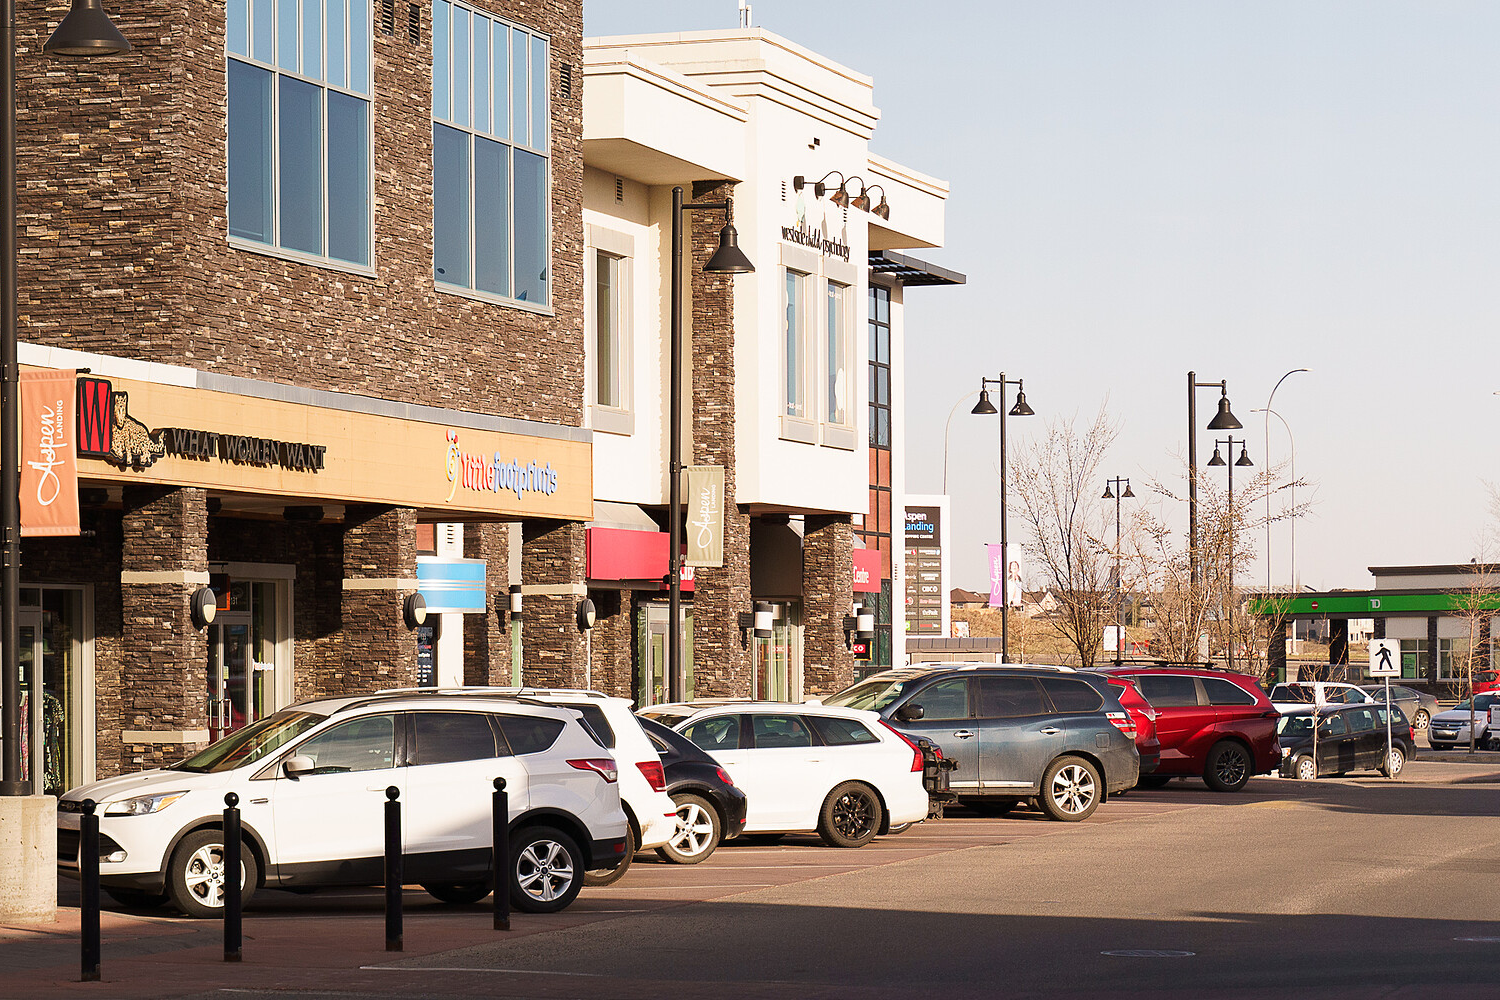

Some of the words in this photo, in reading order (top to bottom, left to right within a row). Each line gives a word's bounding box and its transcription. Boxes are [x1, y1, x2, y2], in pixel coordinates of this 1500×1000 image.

[56, 399, 64, 439] LANDING
[80, 380, 111, 452] W
[27, 404, 68, 506] Aspen
[172, 427, 220, 458] WHAT
[225, 433, 281, 466] WOMEN
[285, 441, 327, 470] WANT
[691, 487, 719, 549] Aspen
[904, 521, 934, 533] anding
[853, 566, 870, 584] Centre
[1369, 599, 1381, 609] TD
